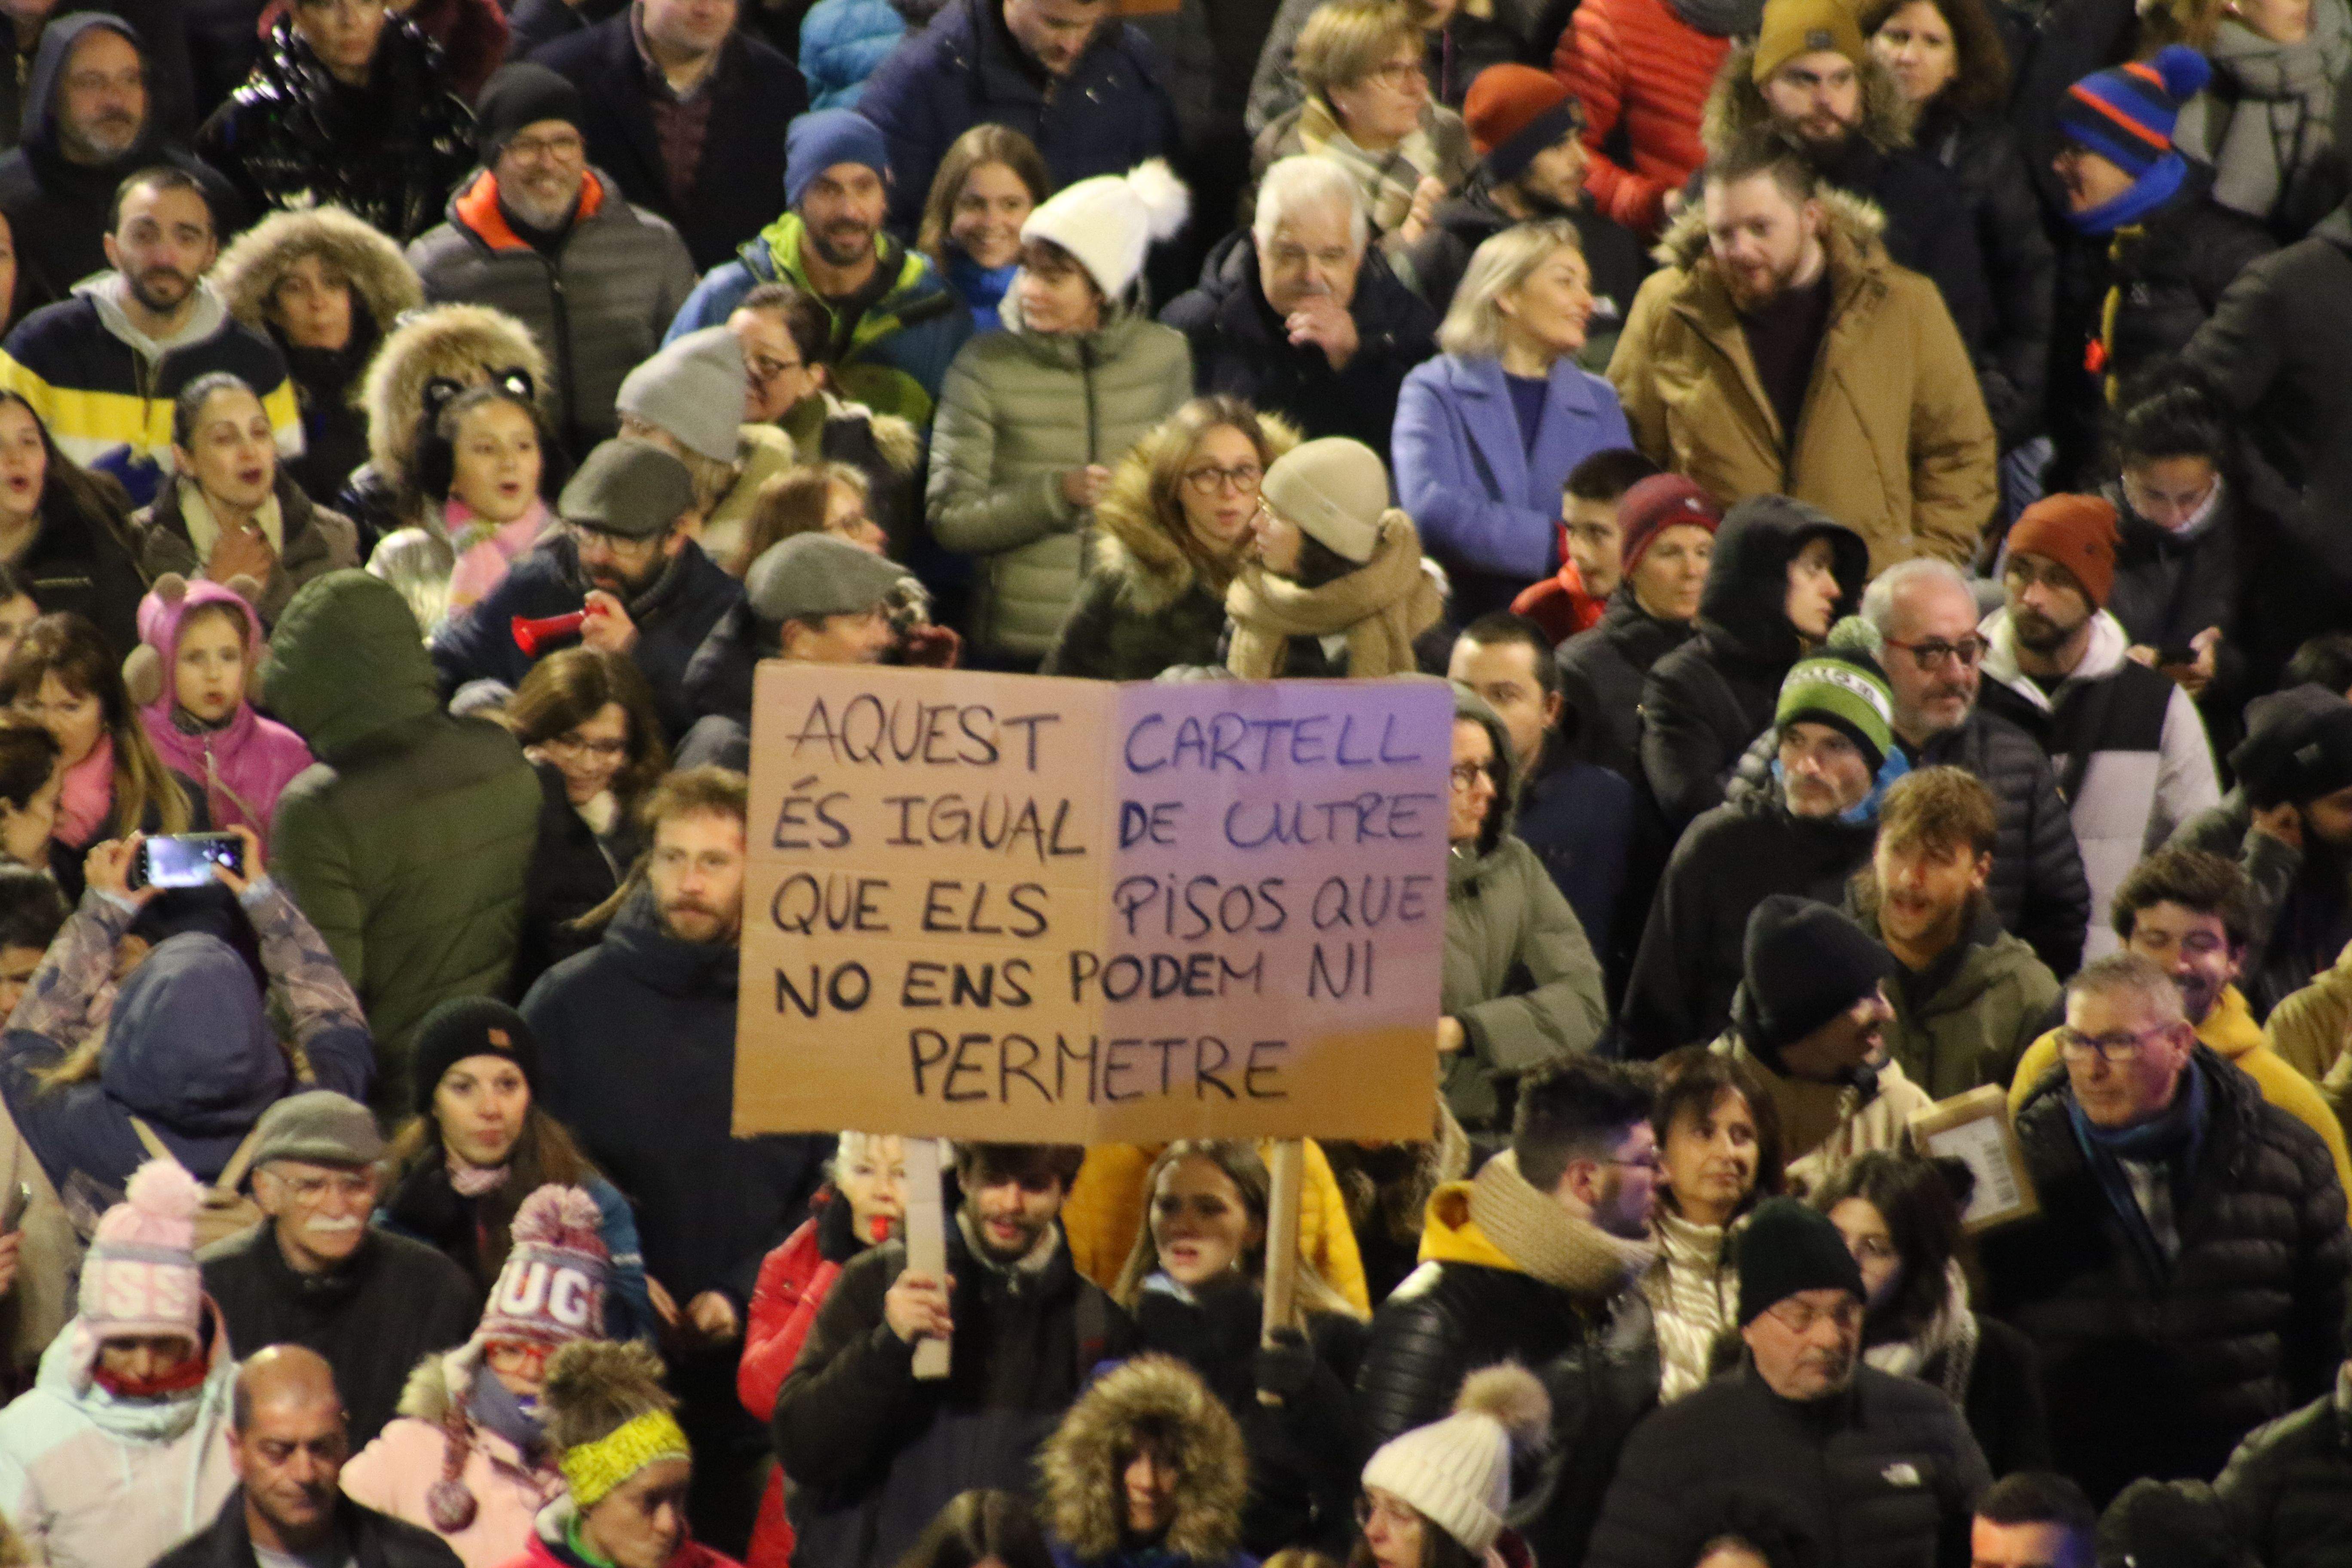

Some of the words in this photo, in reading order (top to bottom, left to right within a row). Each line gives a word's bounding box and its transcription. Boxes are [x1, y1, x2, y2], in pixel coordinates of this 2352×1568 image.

[786, 693, 1060, 772] AQUEST
[1124, 712, 1421, 775] CARTELL
[772, 775, 851, 850] ÉS
[884, 794, 1086, 862] IGUAL
[1118, 800, 1184, 850] DE
[770, 873, 891, 937] QUE
[921, 880, 1049, 940] ELS
[1311, 875, 1433, 932] QUE
[775, 961, 873, 1019] NO
[900, 958, 1033, 1009] ENS
[1069, 950, 1263, 1004] PODEM
[1307, 940, 1373, 1000] NI
[909, 1028, 1288, 1104] PERMETRE
